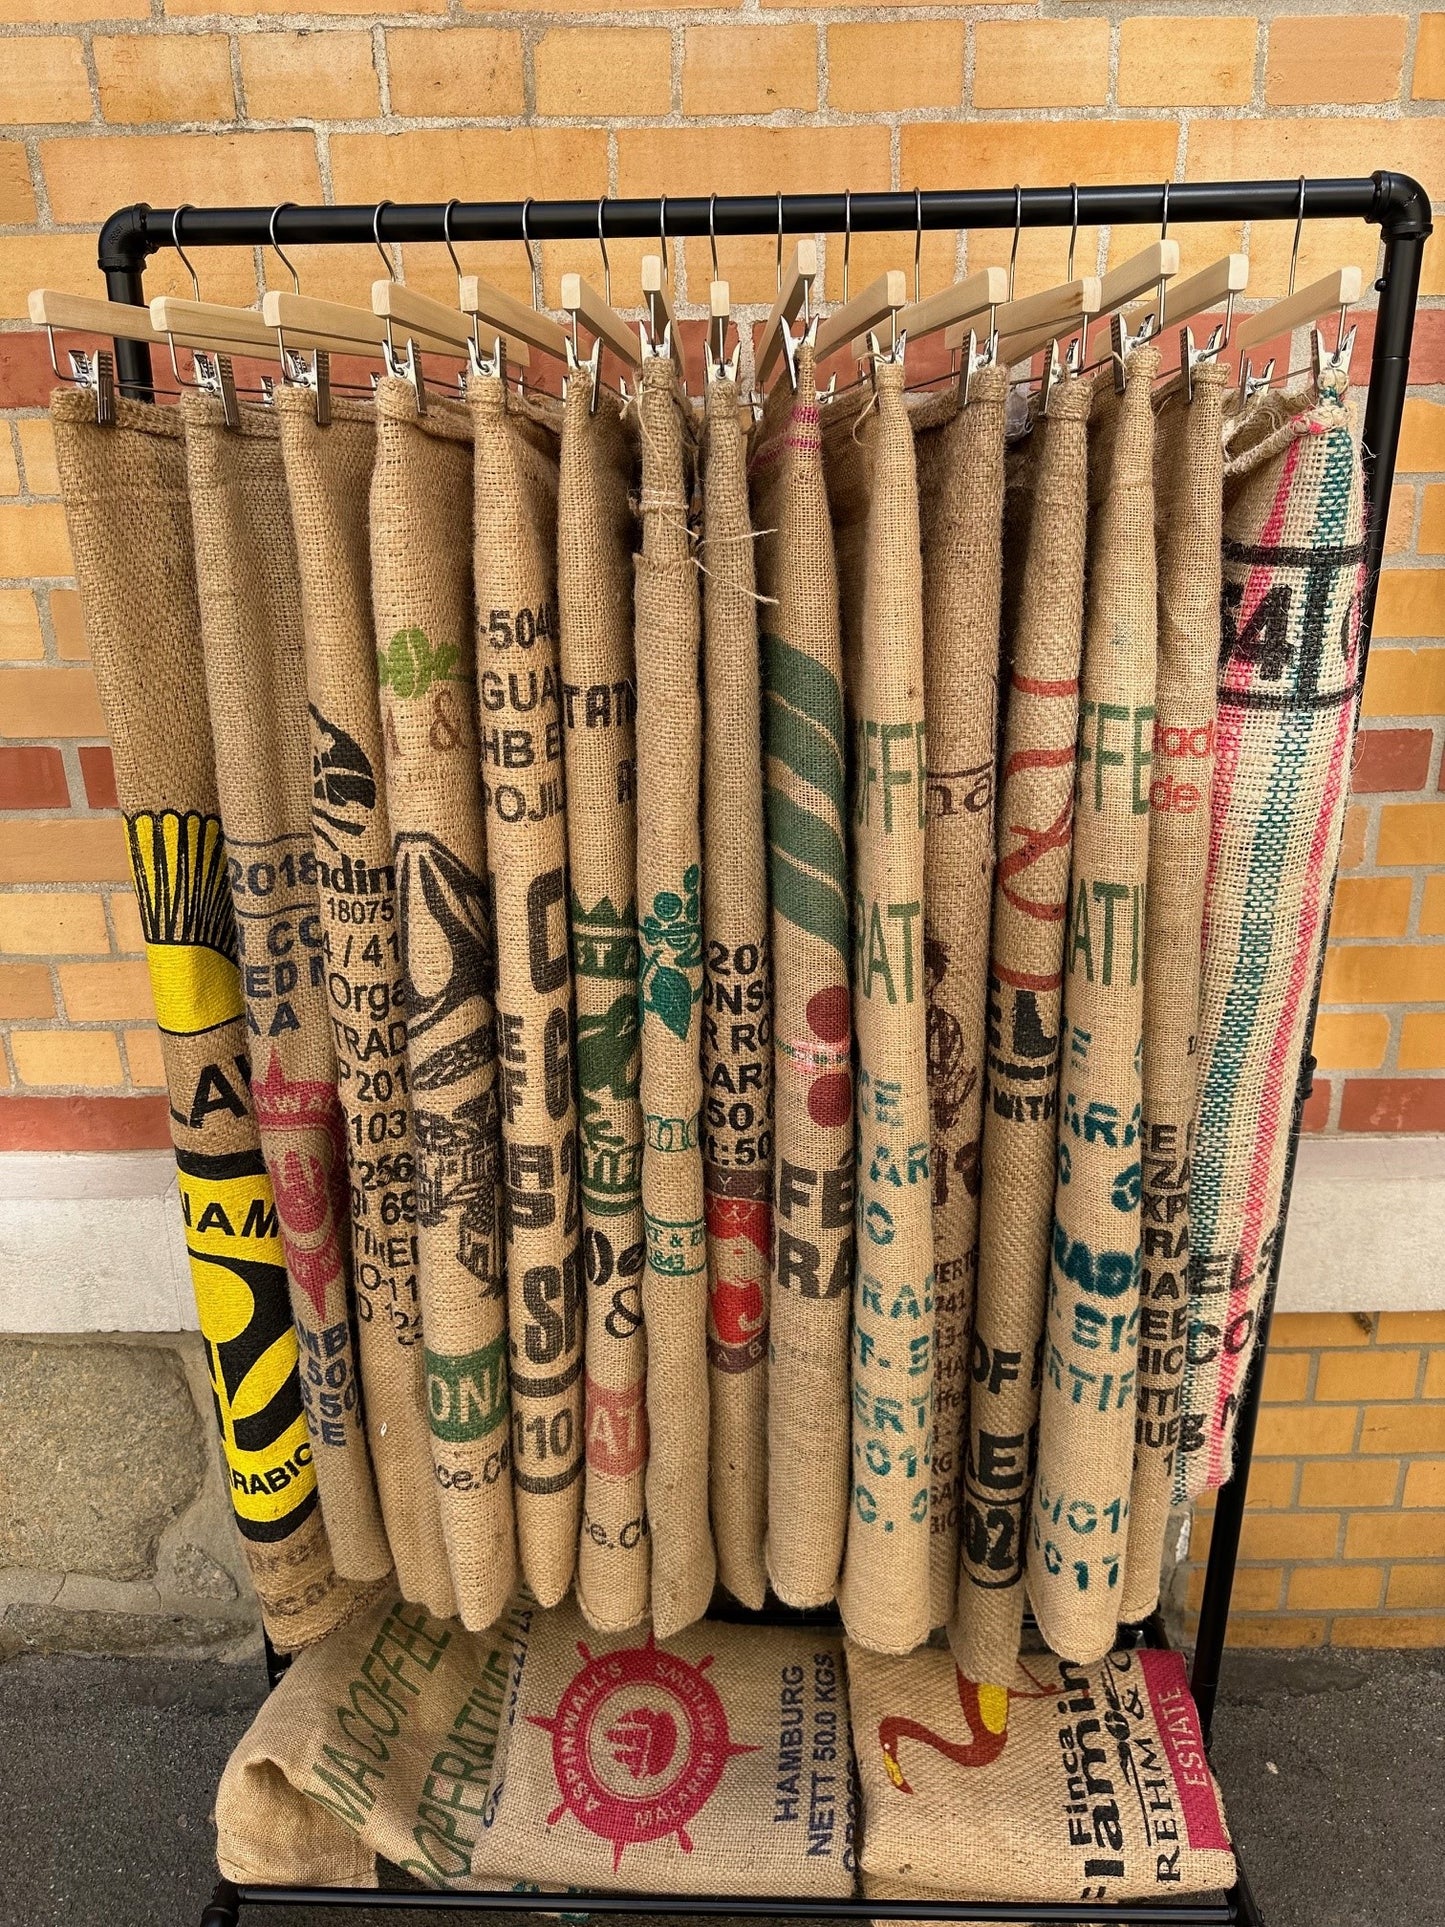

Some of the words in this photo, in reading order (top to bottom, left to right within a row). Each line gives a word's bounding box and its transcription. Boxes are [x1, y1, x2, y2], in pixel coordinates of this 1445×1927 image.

[1149, 775, 1201, 814] de
[228, 852, 317, 897] 2018
[327, 897, 394, 925] 18075
[605, 1286, 644, 1339] &
[336, 1602, 450, 1763] COFFEE
[1121, 1684, 1145, 1720] &
[774, 1665, 805, 1824] HAMBURG
[813, 1711, 837, 1763] 50.0
[1157, 1686, 1209, 1788] ESTATE
[806, 1770, 836, 1858] NETT
[1057, 1724, 1093, 1846] Finca
[1134, 1737, 1181, 1883] REHM
